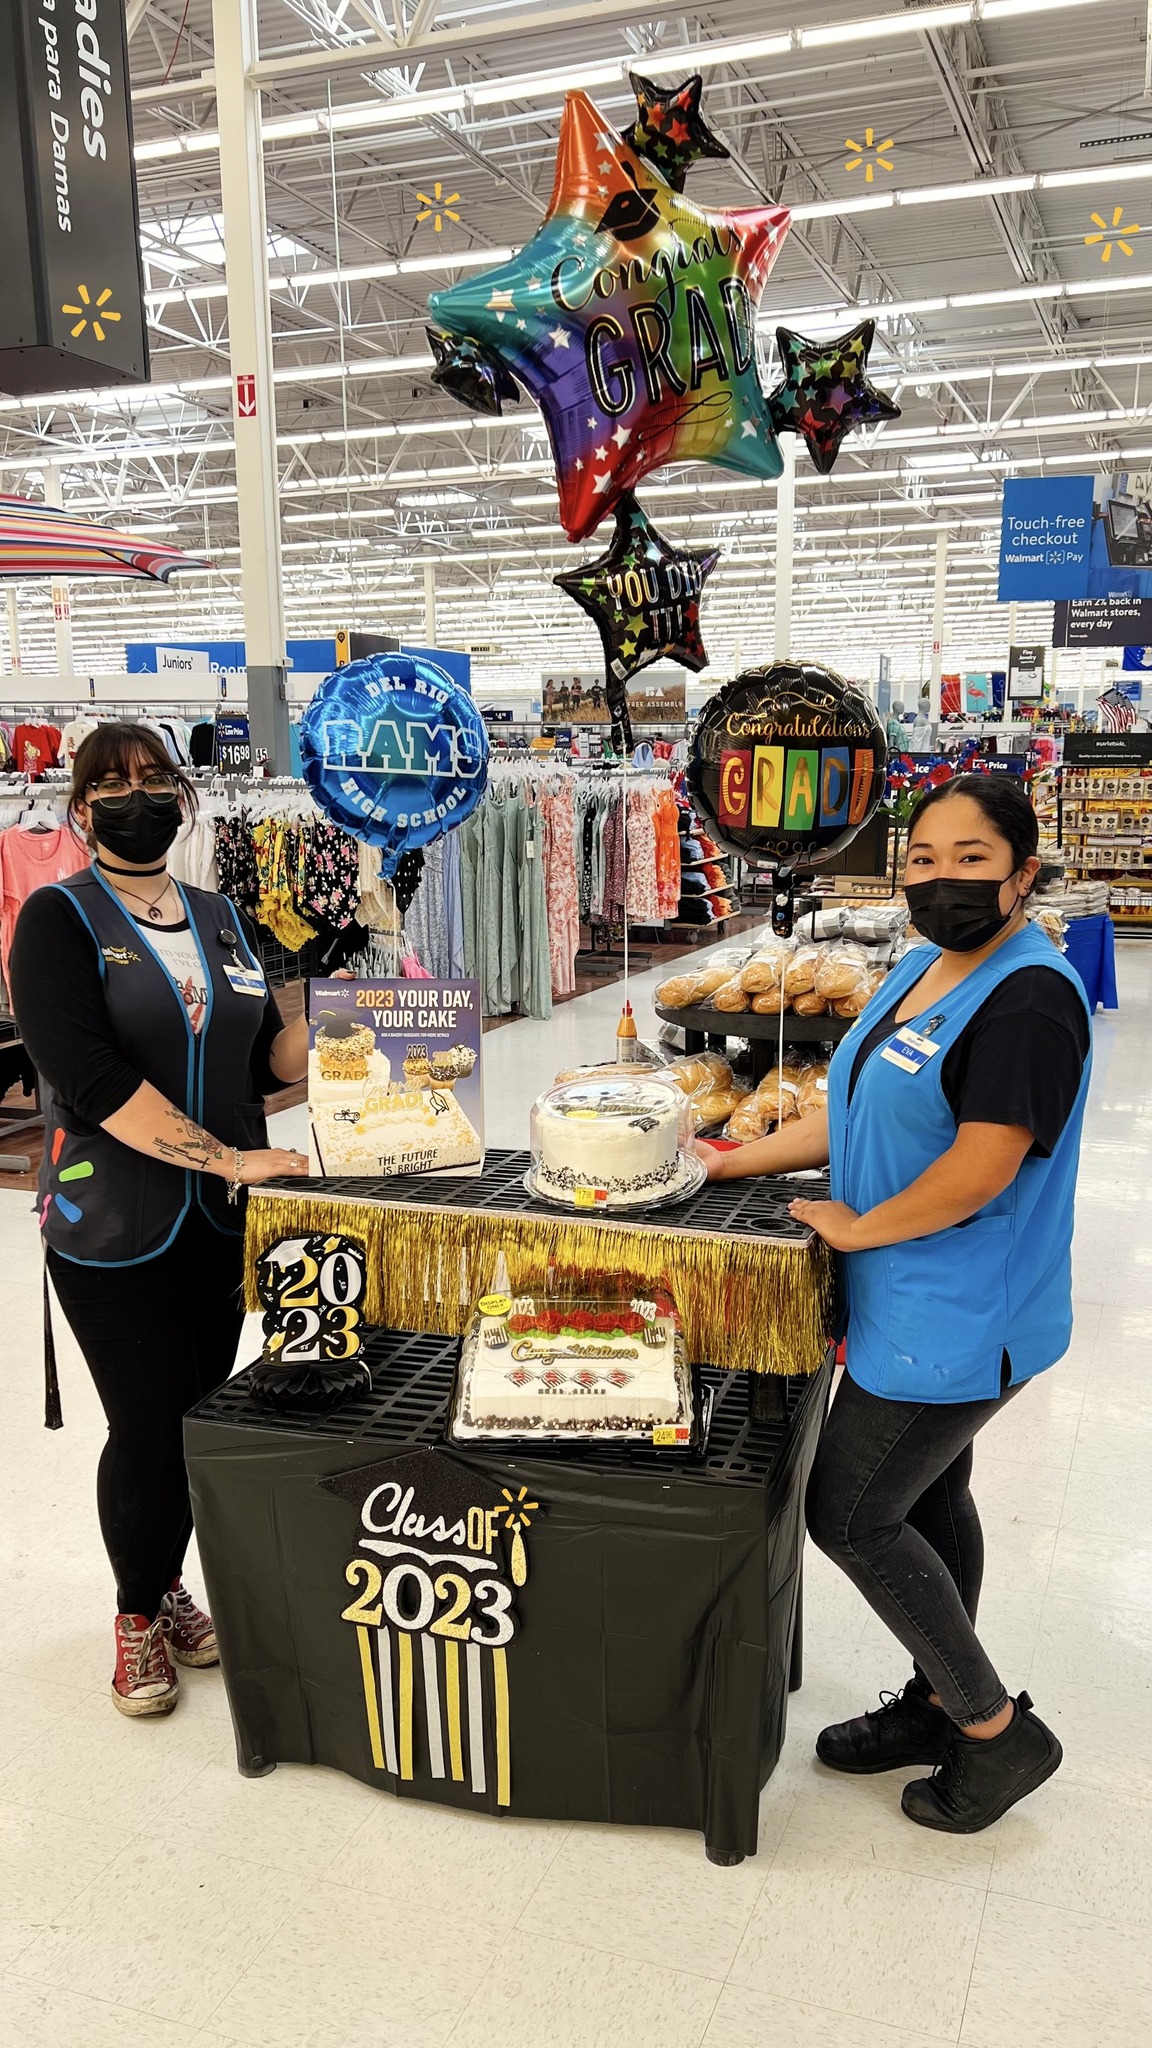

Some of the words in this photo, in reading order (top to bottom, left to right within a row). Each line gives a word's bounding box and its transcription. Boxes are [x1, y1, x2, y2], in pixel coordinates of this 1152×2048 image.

[74, 0, 112, 162] adies
[38, 16, 62, 101] para
[50, 110, 72, 233] Damas
[551, 218, 747, 316] Congrats
[584, 275, 754, 418] GRAD
[1008, 515, 1086, 531] Touch-free
[1012, 532, 1079, 546] checkout
[1005, 553, 1044, 564] Walmart
[1066, 552, 1083, 564] Pay
[606, 568, 660, 611] YOU
[665, 560, 703, 600] DID
[1071, 599, 1092, 607] Earn
[1109, 598, 1131, 606] back
[1071, 609, 1108, 617] Walmart
[1110, 609, 1141, 617] stores,
[649, 603, 684, 645] IT!
[1070, 621, 1095, 630] every
[1096, 619, 1113, 630] day
[163, 654, 193, 670] Juniors'
[364, 676, 406, 699] DEL
[415, 679, 450, 705] RIO
[647, 700, 683, 708] ASSEMBLY
[727, 711, 873, 745] Congratulations
[323, 719, 482, 779] RAMS
[989, 761, 1008, 769] Price
[340, 777, 388, 823] HIGH
[396, 786, 467, 829] SCHOOL
[355, 989, 395, 1008] 2023
[397, 989, 439, 1008] YOUR
[442, 989, 474, 1011] DAY,
[372, 1010, 414, 1028] YOUR
[417, 1010, 457, 1028] CAKE
[406, 1044, 428, 1060] 2023
[901, 1046, 915, 1057] EVA
[321, 1070, 370, 1081] GRAD!
[364, 1092, 424, 1113] GRAD!
[377, 1155, 397, 1167] THE
[401, 1149, 439, 1163] FUTURE
[383, 1166, 393, 1176] IS
[397, 1160, 433, 1174] BRIGHT
[280, 1252, 362, 1308] 20
[480, 1298, 507, 1307] DISPLAY
[281, 1305, 361, 1363] 23
[511, 1339, 639, 1366] Congratulations
[361, 1482, 466, 1546] Class
[467, 1506, 500, 1555] OF
[341, 1559, 515, 1646] 2023
